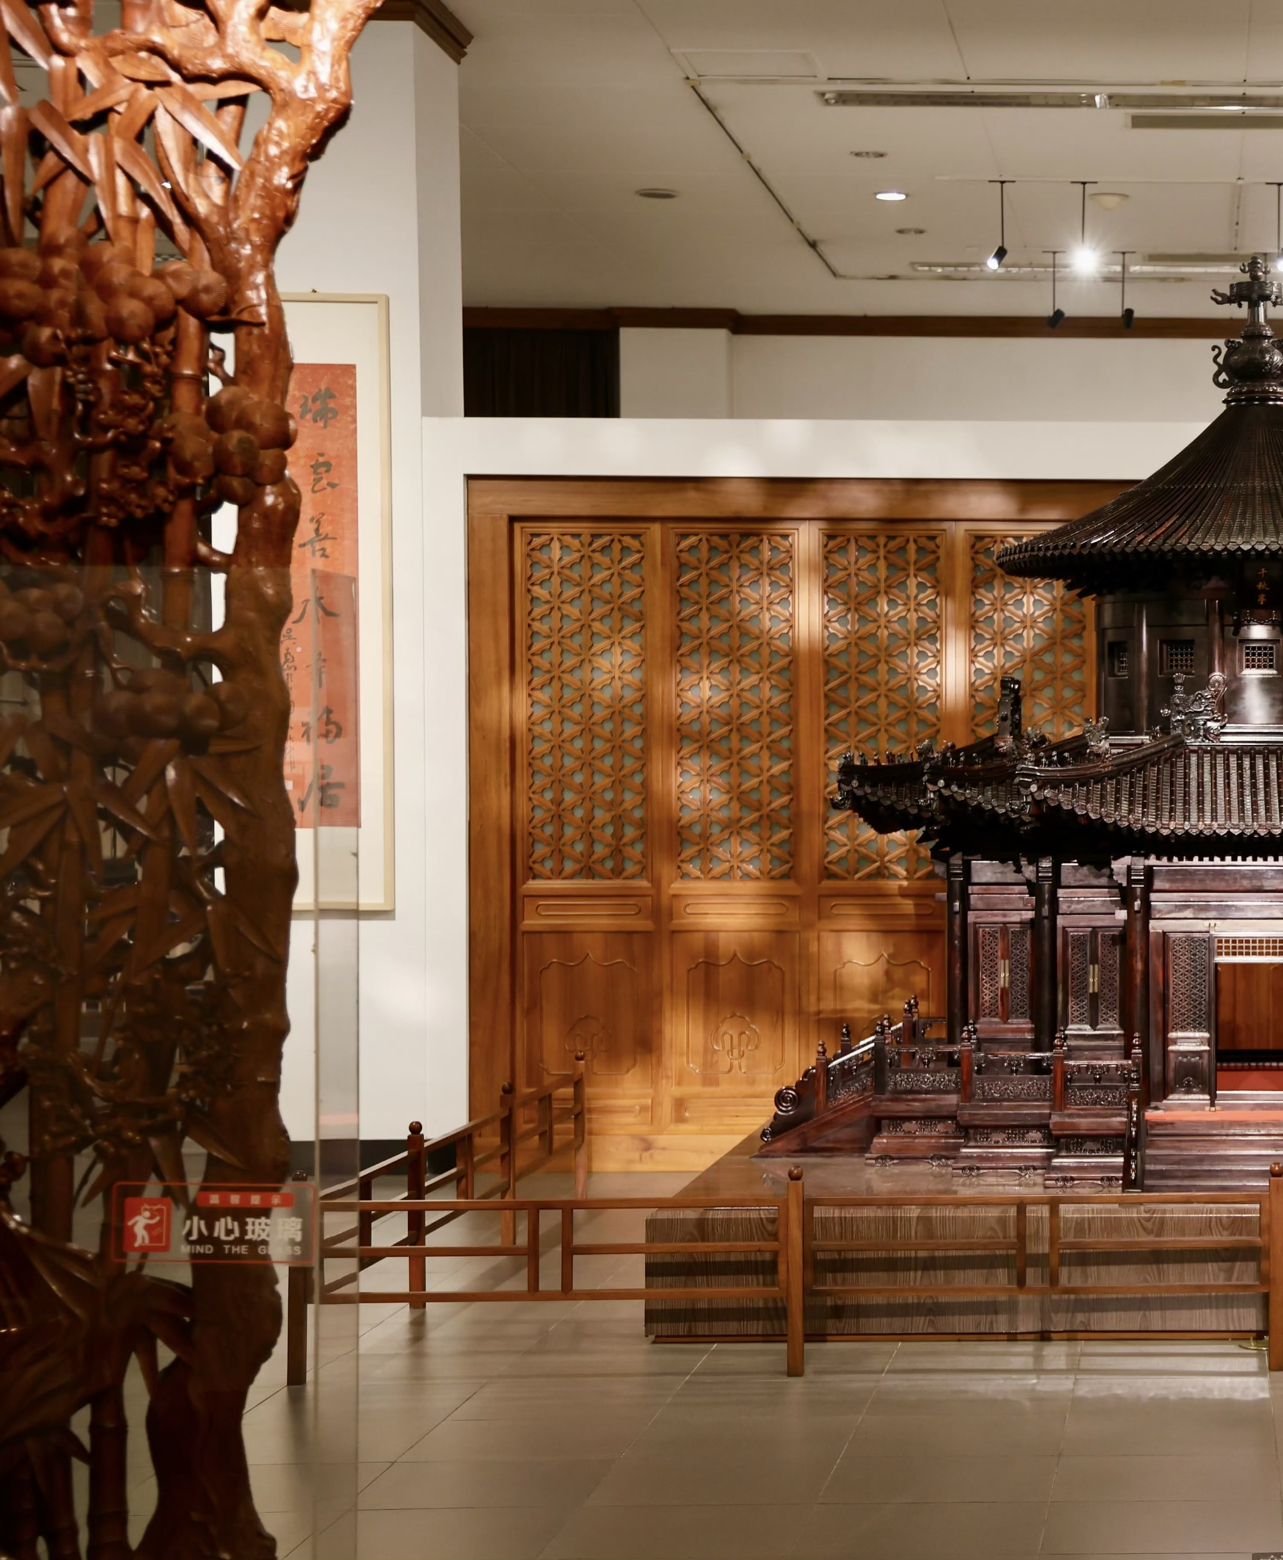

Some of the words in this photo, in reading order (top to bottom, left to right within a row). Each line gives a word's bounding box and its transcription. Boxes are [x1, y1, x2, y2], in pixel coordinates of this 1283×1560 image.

[182, 1216, 303, 1242] 小心玻璃
[181, 1245, 214, 1254] MIND
[223, 1245, 249, 1255] THE
